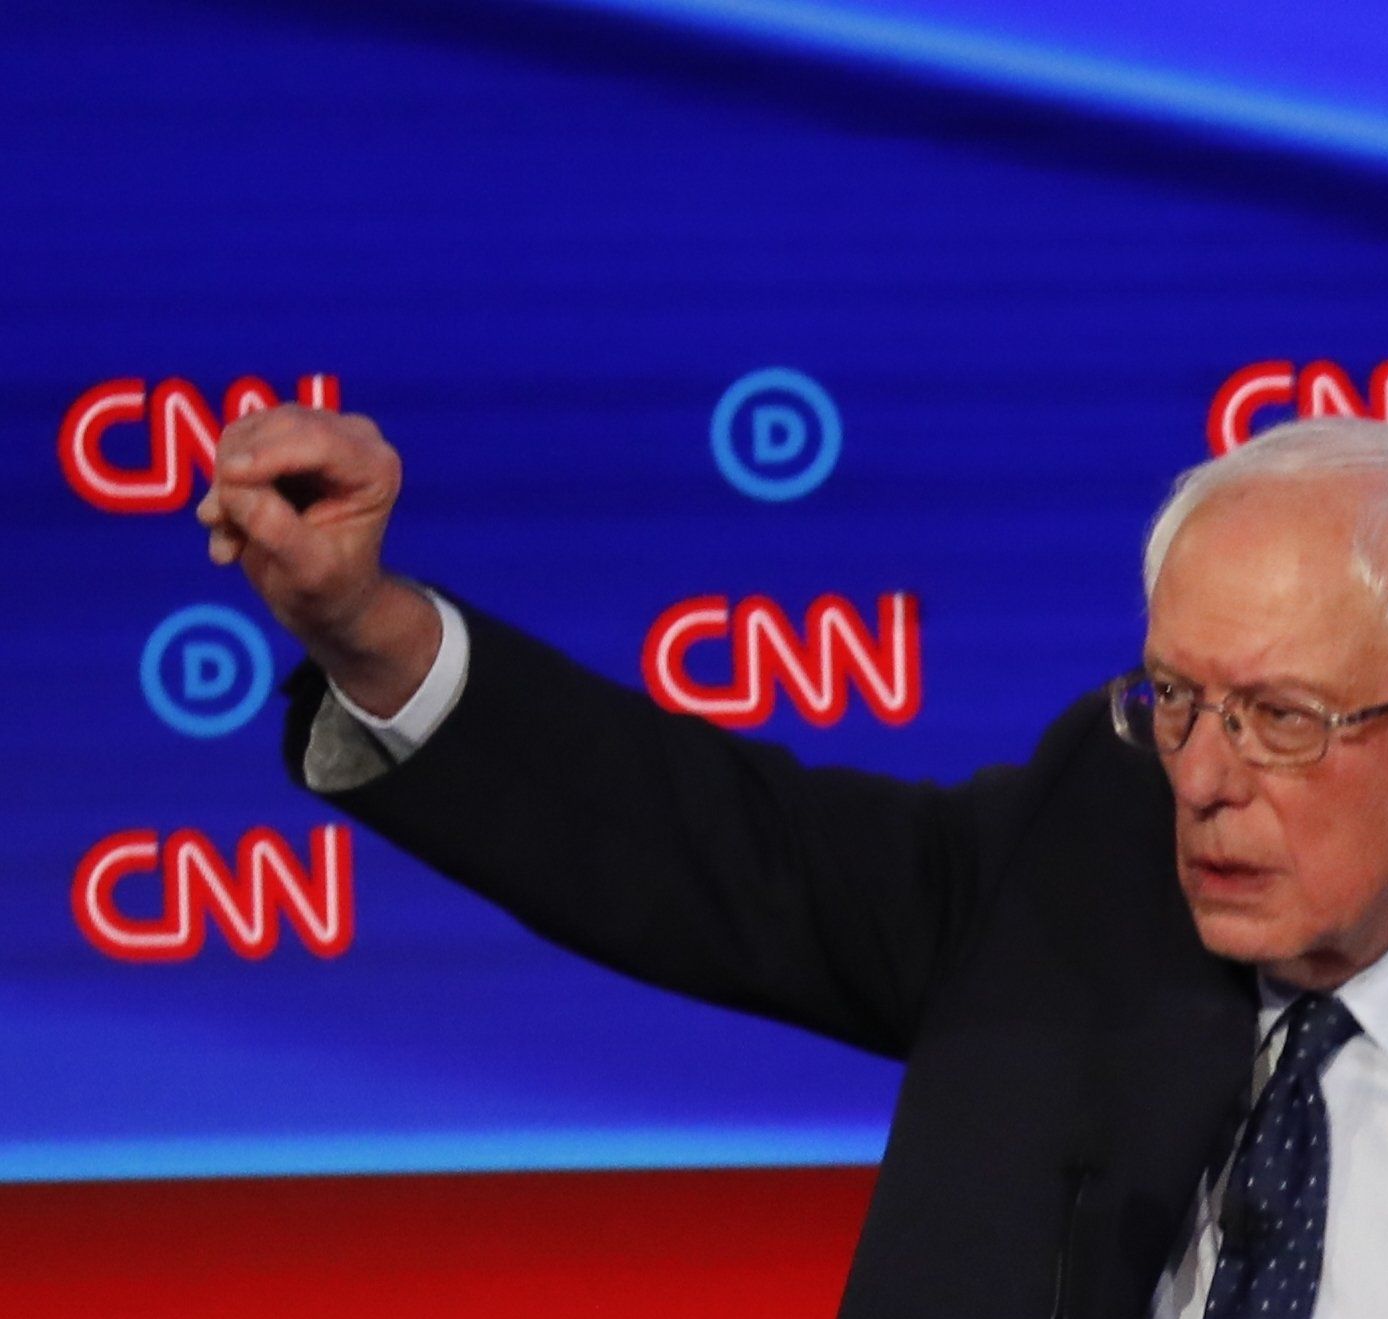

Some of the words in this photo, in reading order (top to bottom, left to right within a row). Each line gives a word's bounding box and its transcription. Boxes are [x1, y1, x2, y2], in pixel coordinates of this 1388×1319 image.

[58, 374, 341, 514] CN
[641, 594, 923, 729] CNN
[71, 825, 355, 963] CNN
